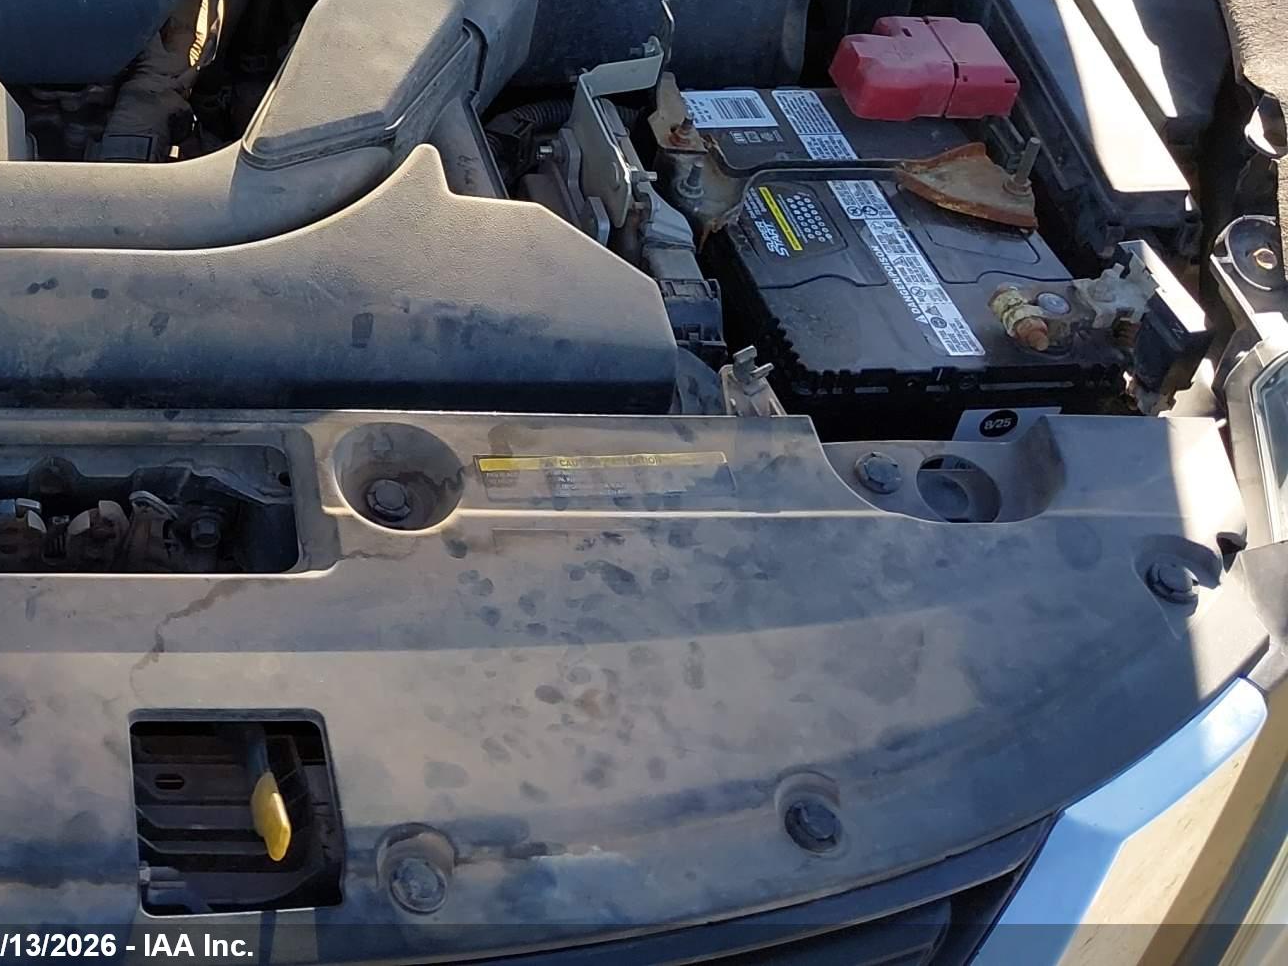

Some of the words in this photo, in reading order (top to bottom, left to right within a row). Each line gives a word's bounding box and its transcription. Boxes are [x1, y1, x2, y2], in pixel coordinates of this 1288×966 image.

[754, 220, 776, 252] SUPER
[761, 219, 790, 257] START
[983, 417, 1013, 431] 8/25
